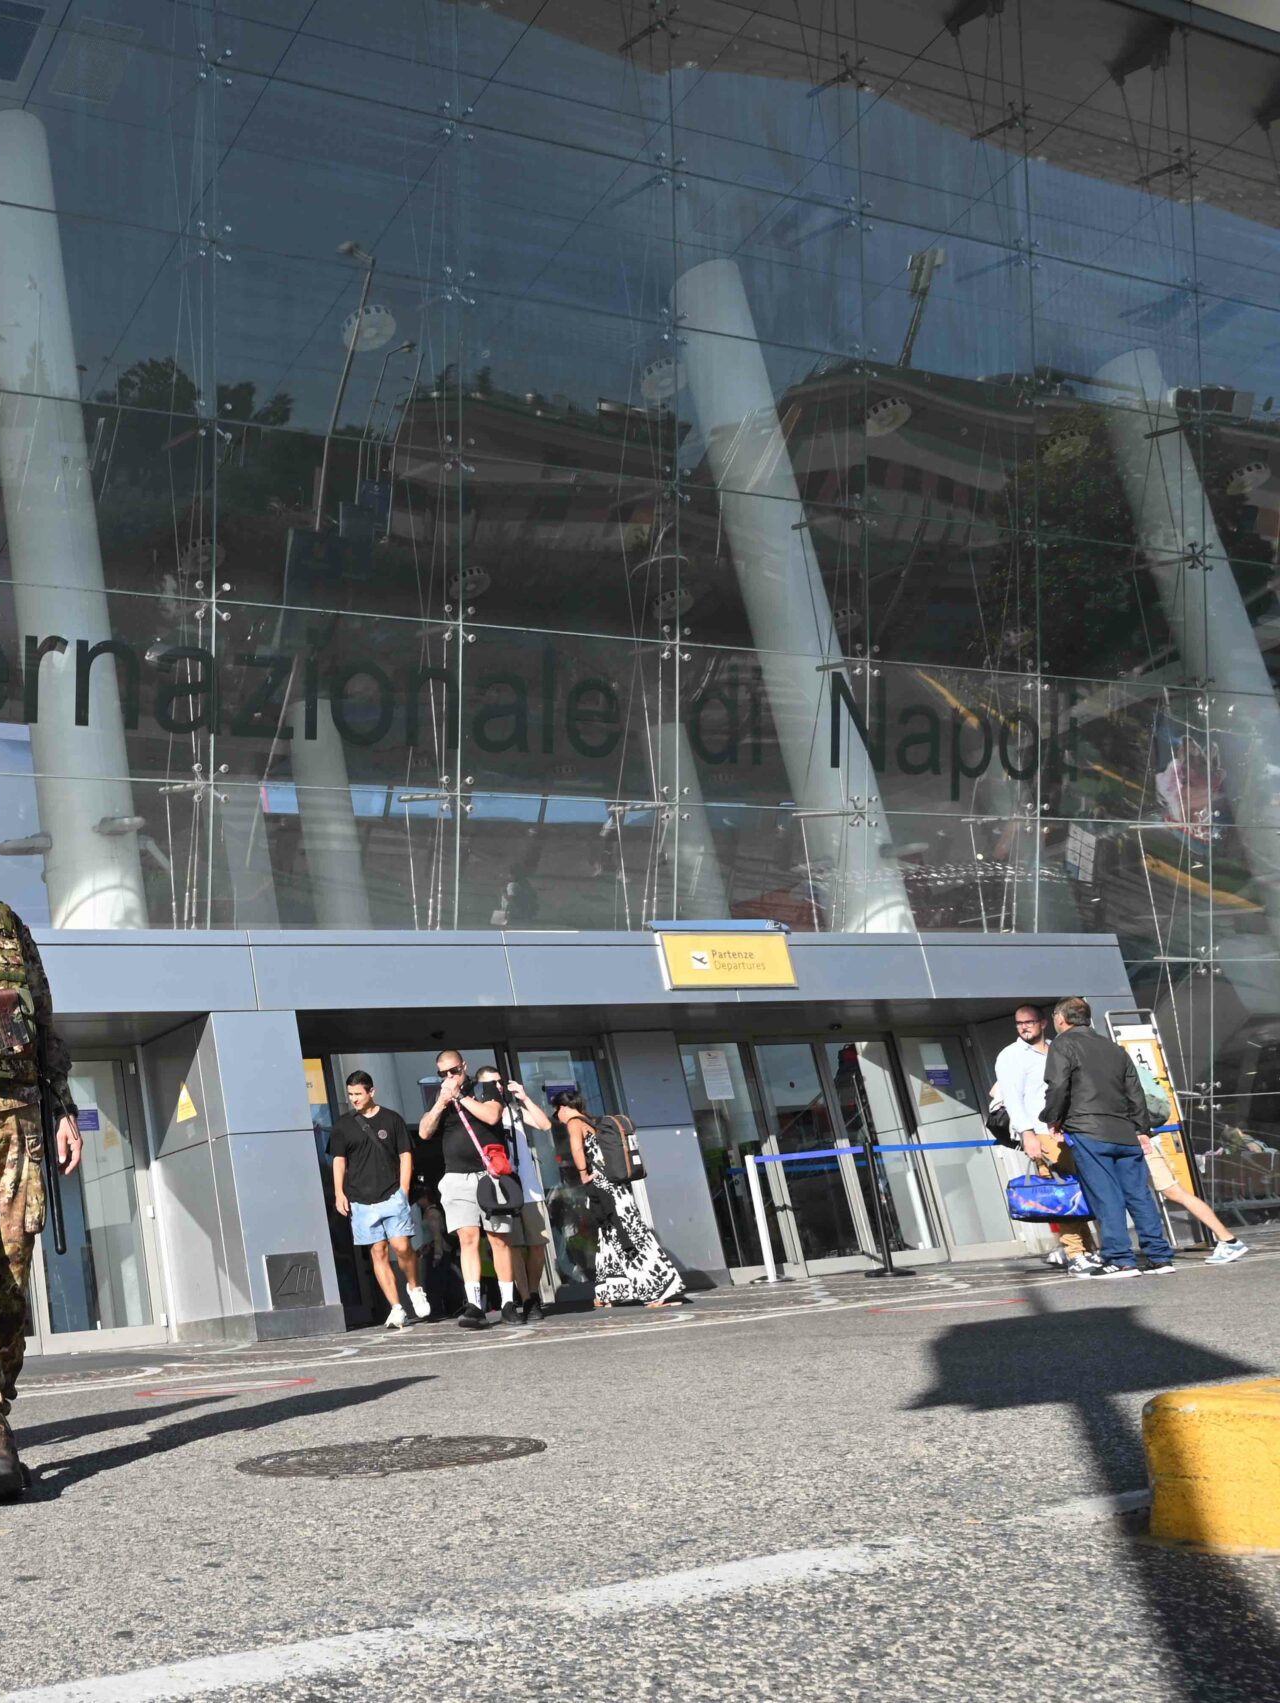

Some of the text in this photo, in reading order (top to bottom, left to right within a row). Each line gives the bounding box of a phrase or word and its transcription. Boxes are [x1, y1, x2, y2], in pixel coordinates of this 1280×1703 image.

[689, 663, 762, 766] di
[830, 671, 1079, 802] Napoli
[711, 949, 754, 959] Partenze
[714, 961, 766, 971] Departures
